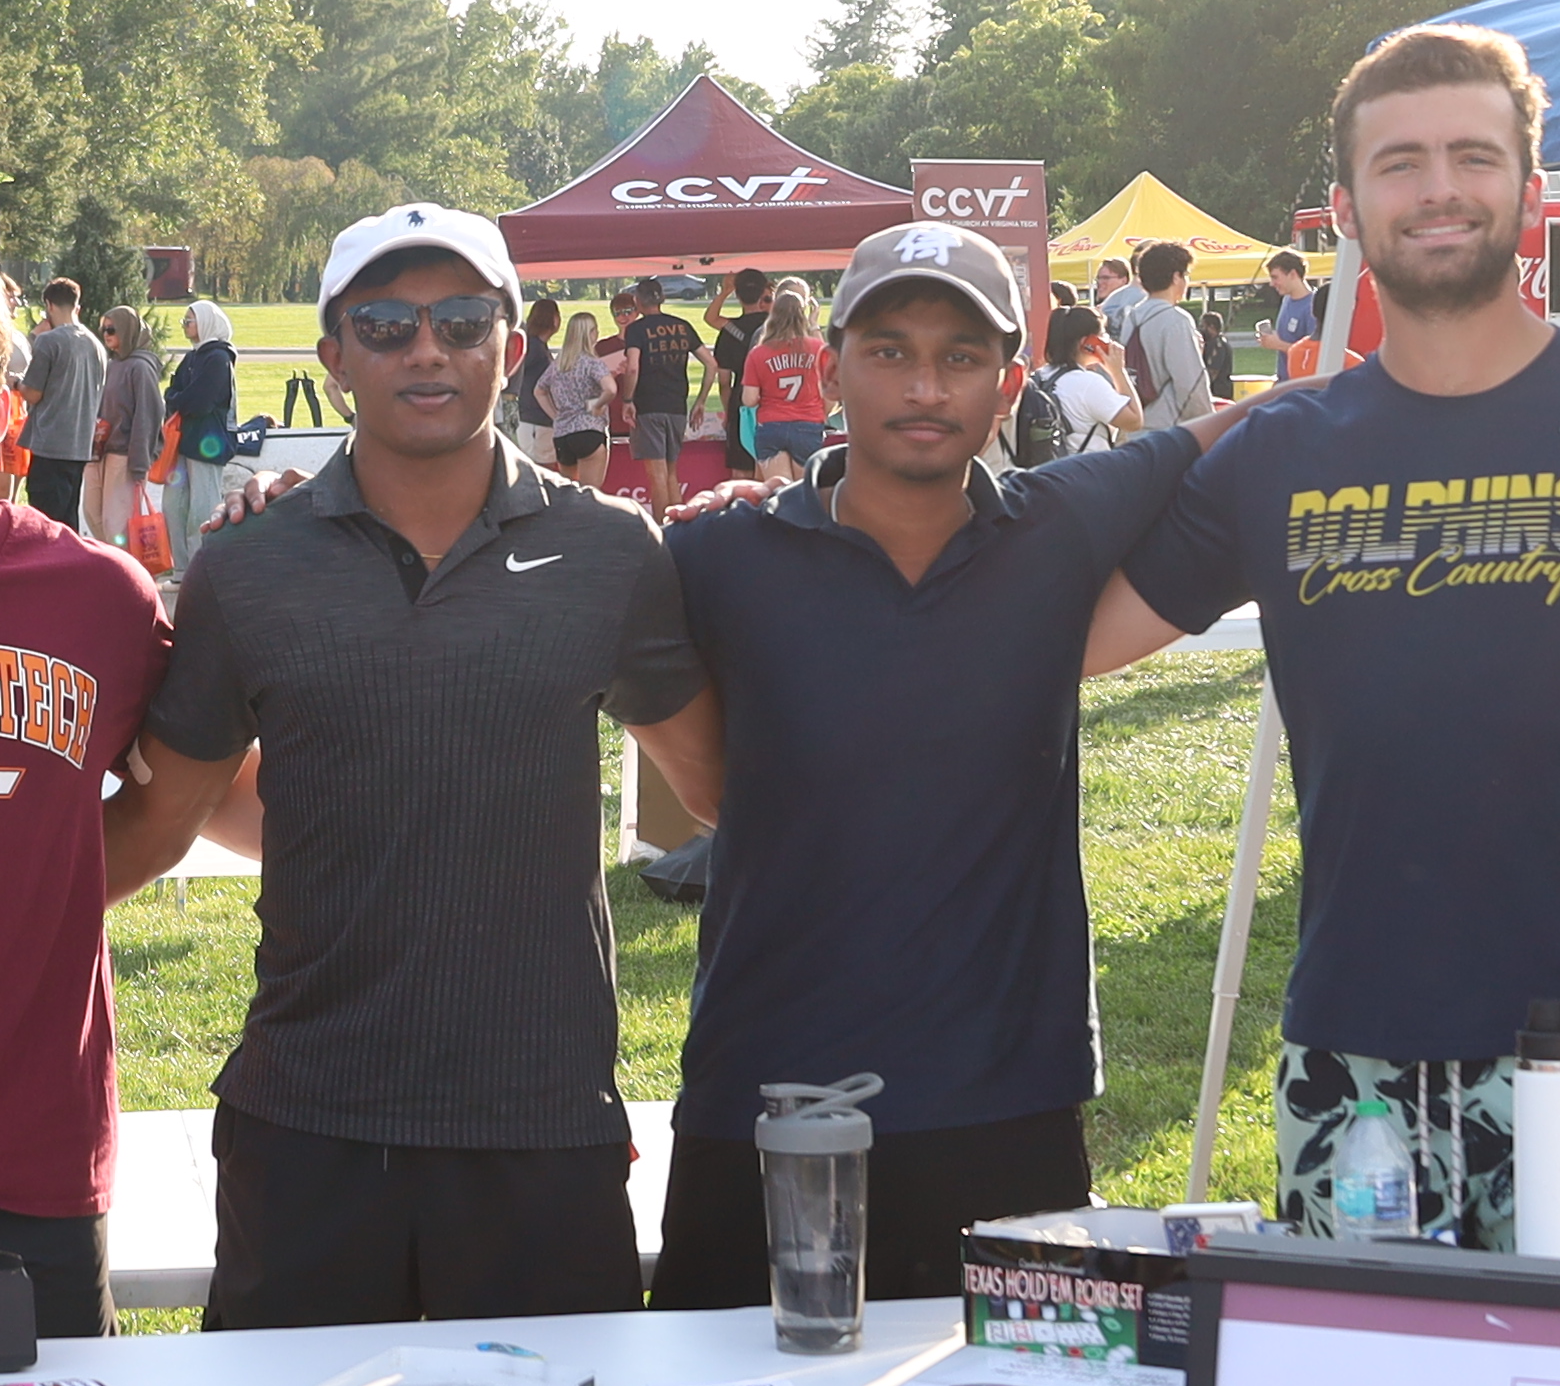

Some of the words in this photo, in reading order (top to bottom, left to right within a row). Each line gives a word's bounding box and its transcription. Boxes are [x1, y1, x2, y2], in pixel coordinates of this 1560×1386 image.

[646, 323, 688, 339] LOVE
[649, 338, 689, 353] LEAD
[765, 353, 816, 374] TURNER
[779, 375, 804, 401] 7
[1298, 550, 1406, 606] Cross
[963, 1263, 1005, 1296] TEXAS
[1005, 1270, 1073, 1304] HOLD'EM
[1075, 1279, 1119, 1309] POKER
[1119, 1283, 1144, 1311] SET
